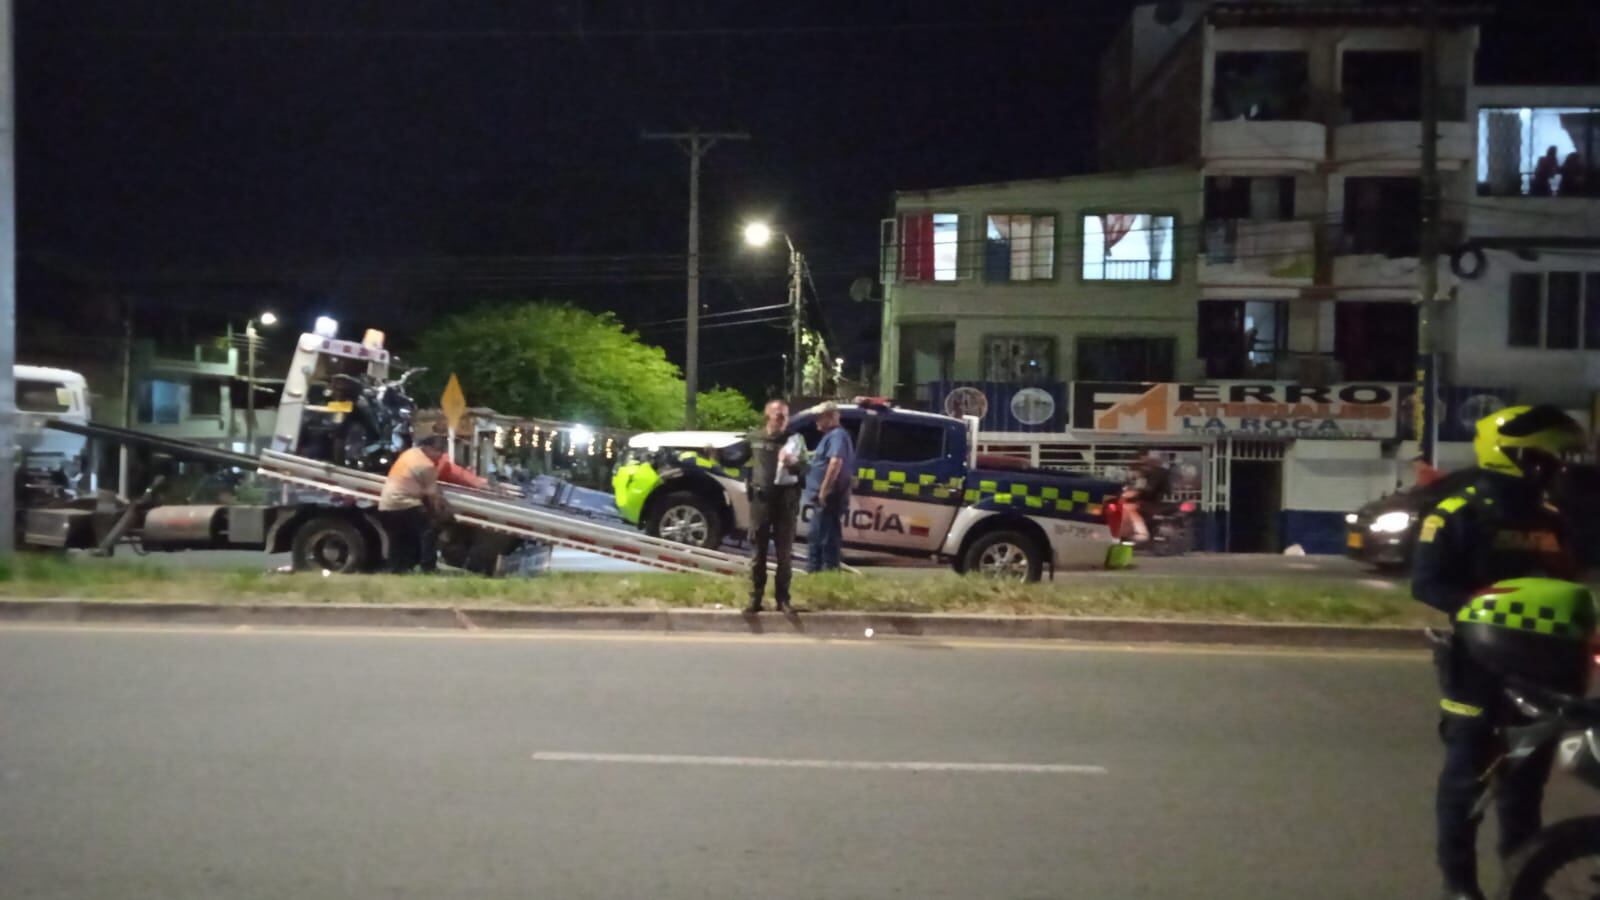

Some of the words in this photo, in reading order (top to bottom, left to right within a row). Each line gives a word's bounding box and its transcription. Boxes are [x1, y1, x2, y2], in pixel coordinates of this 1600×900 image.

[1184, 417, 1225, 429] LA
[1241, 418, 1338, 430] ROCA
[802, 504, 904, 534] OICÍA
